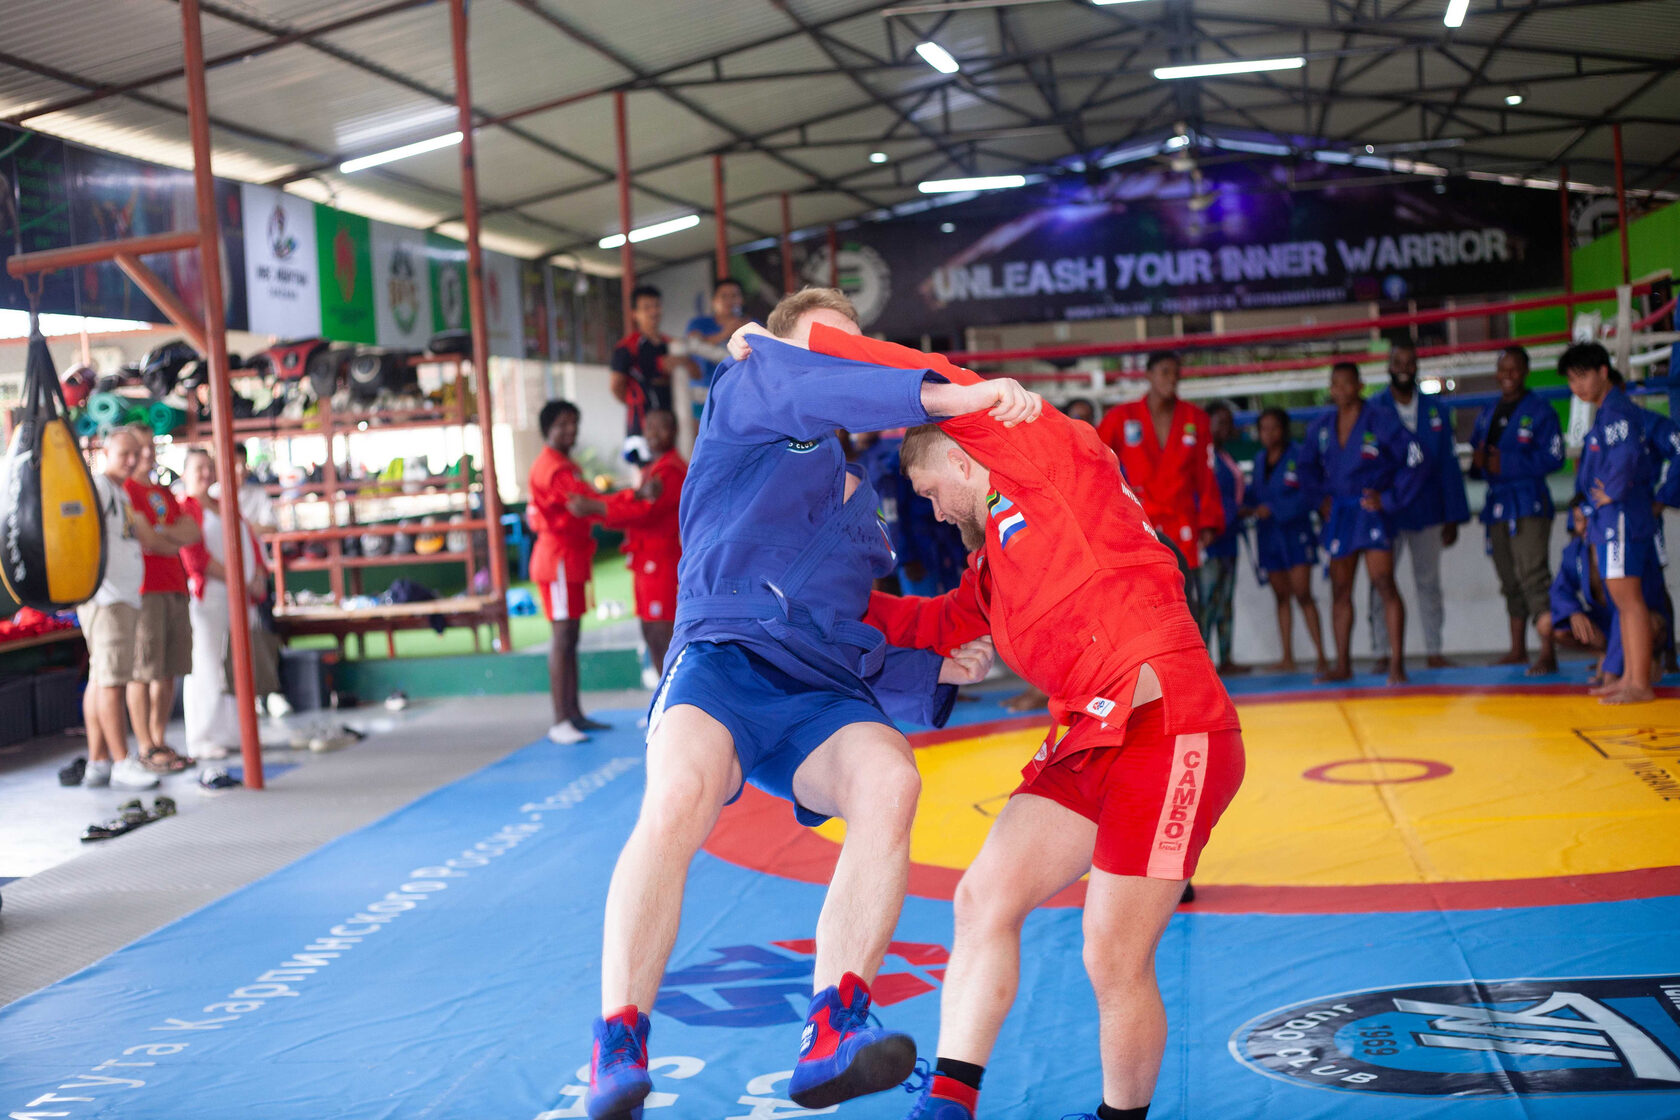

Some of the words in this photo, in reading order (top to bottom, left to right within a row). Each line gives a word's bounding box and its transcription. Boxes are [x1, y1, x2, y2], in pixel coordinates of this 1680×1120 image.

[932, 255, 1107, 301] UNLEASH
[1114, 248, 1214, 290] YOUR
[1218, 240, 1328, 283] INNER
[1334, 227, 1508, 273] WARRIOR
[1164, 751, 1200, 839] САМБО
[150, 880, 447, 1031] Карпинского
[1276, 1046, 1378, 1084] CLUB
[1359, 1025, 1399, 1056] 1969
